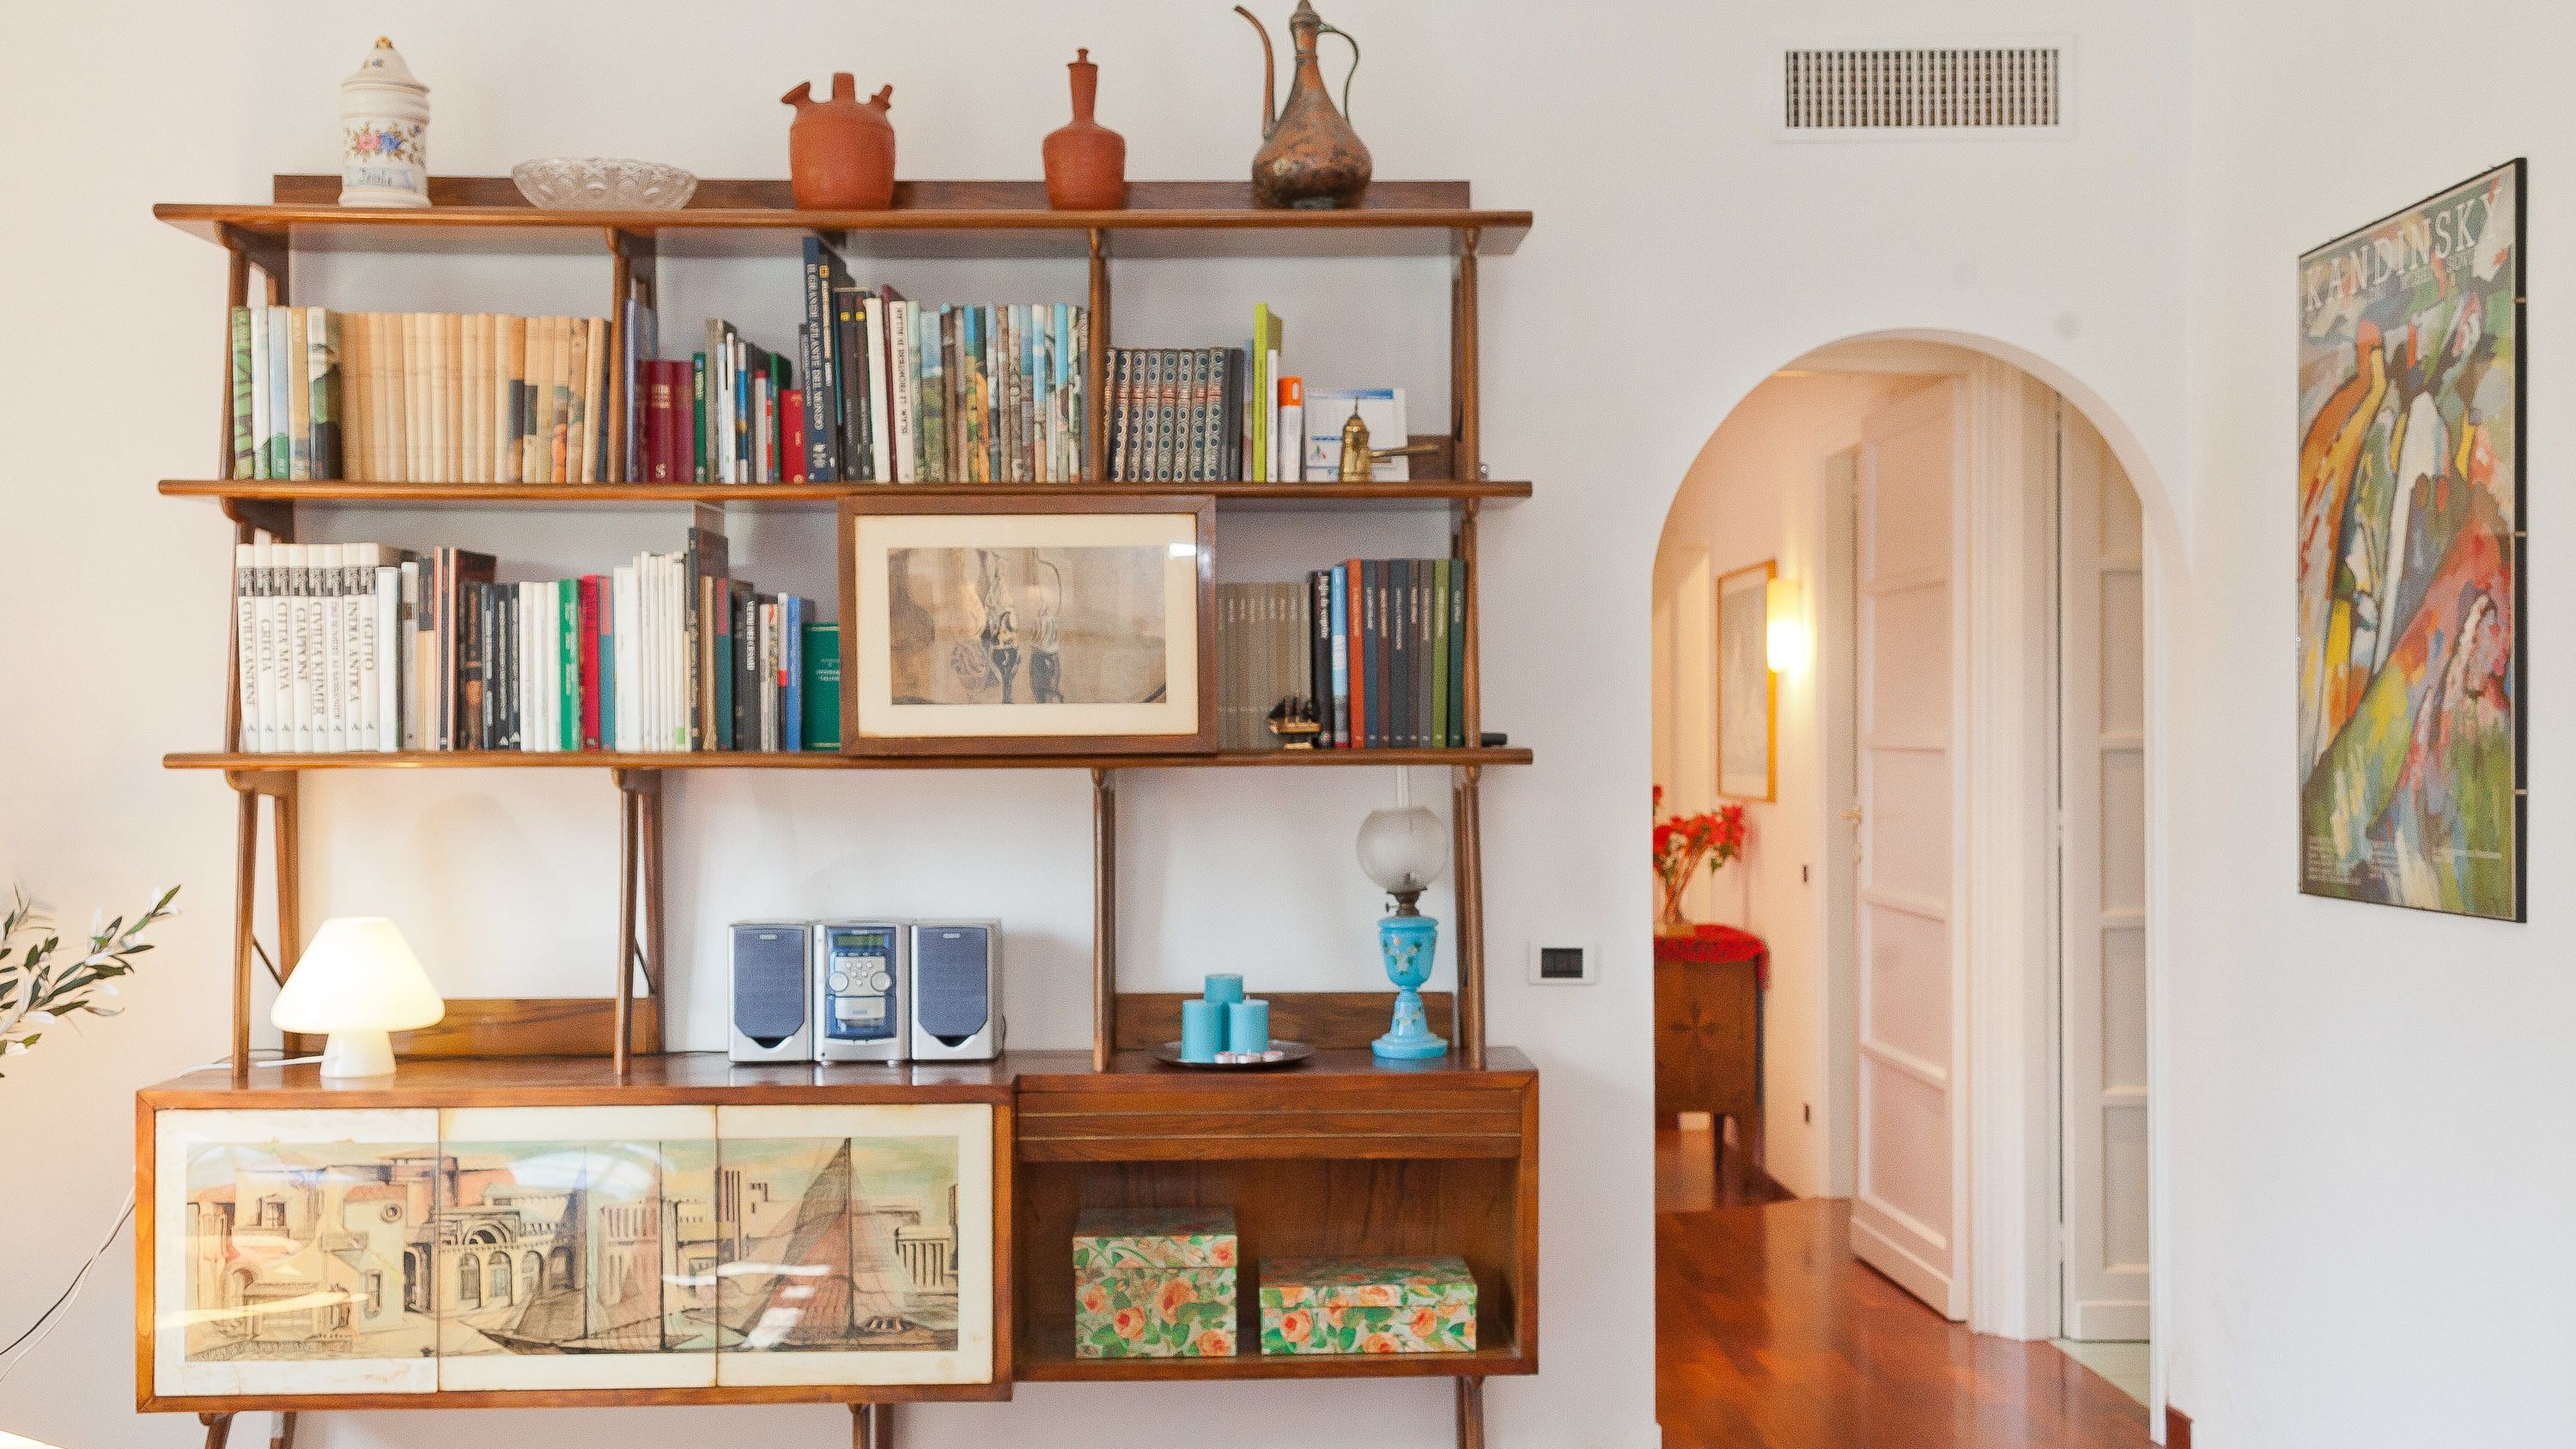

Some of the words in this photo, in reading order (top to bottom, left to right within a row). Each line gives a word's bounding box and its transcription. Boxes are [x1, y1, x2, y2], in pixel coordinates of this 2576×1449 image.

[806, 263, 817, 274] IL
[2306, 188, 2502, 312] KANDINSKY
[807, 275, 818, 318] GRANDE
[809, 321, 821, 368] ATLANTE
[811, 369, 822, 391] DEL
[812, 391, 824, 431] MONDO
[260, 618, 272, 672] GRECIA
[295, 607, 308, 681] GIAPPONE
[347, 601, 359, 643] INDIA
[363, 616, 375, 672] EGITTO
[279, 649, 290, 690] MAYA
[313, 661, 325, 715] KHMER
[348, 648, 360, 703] ANTICA
